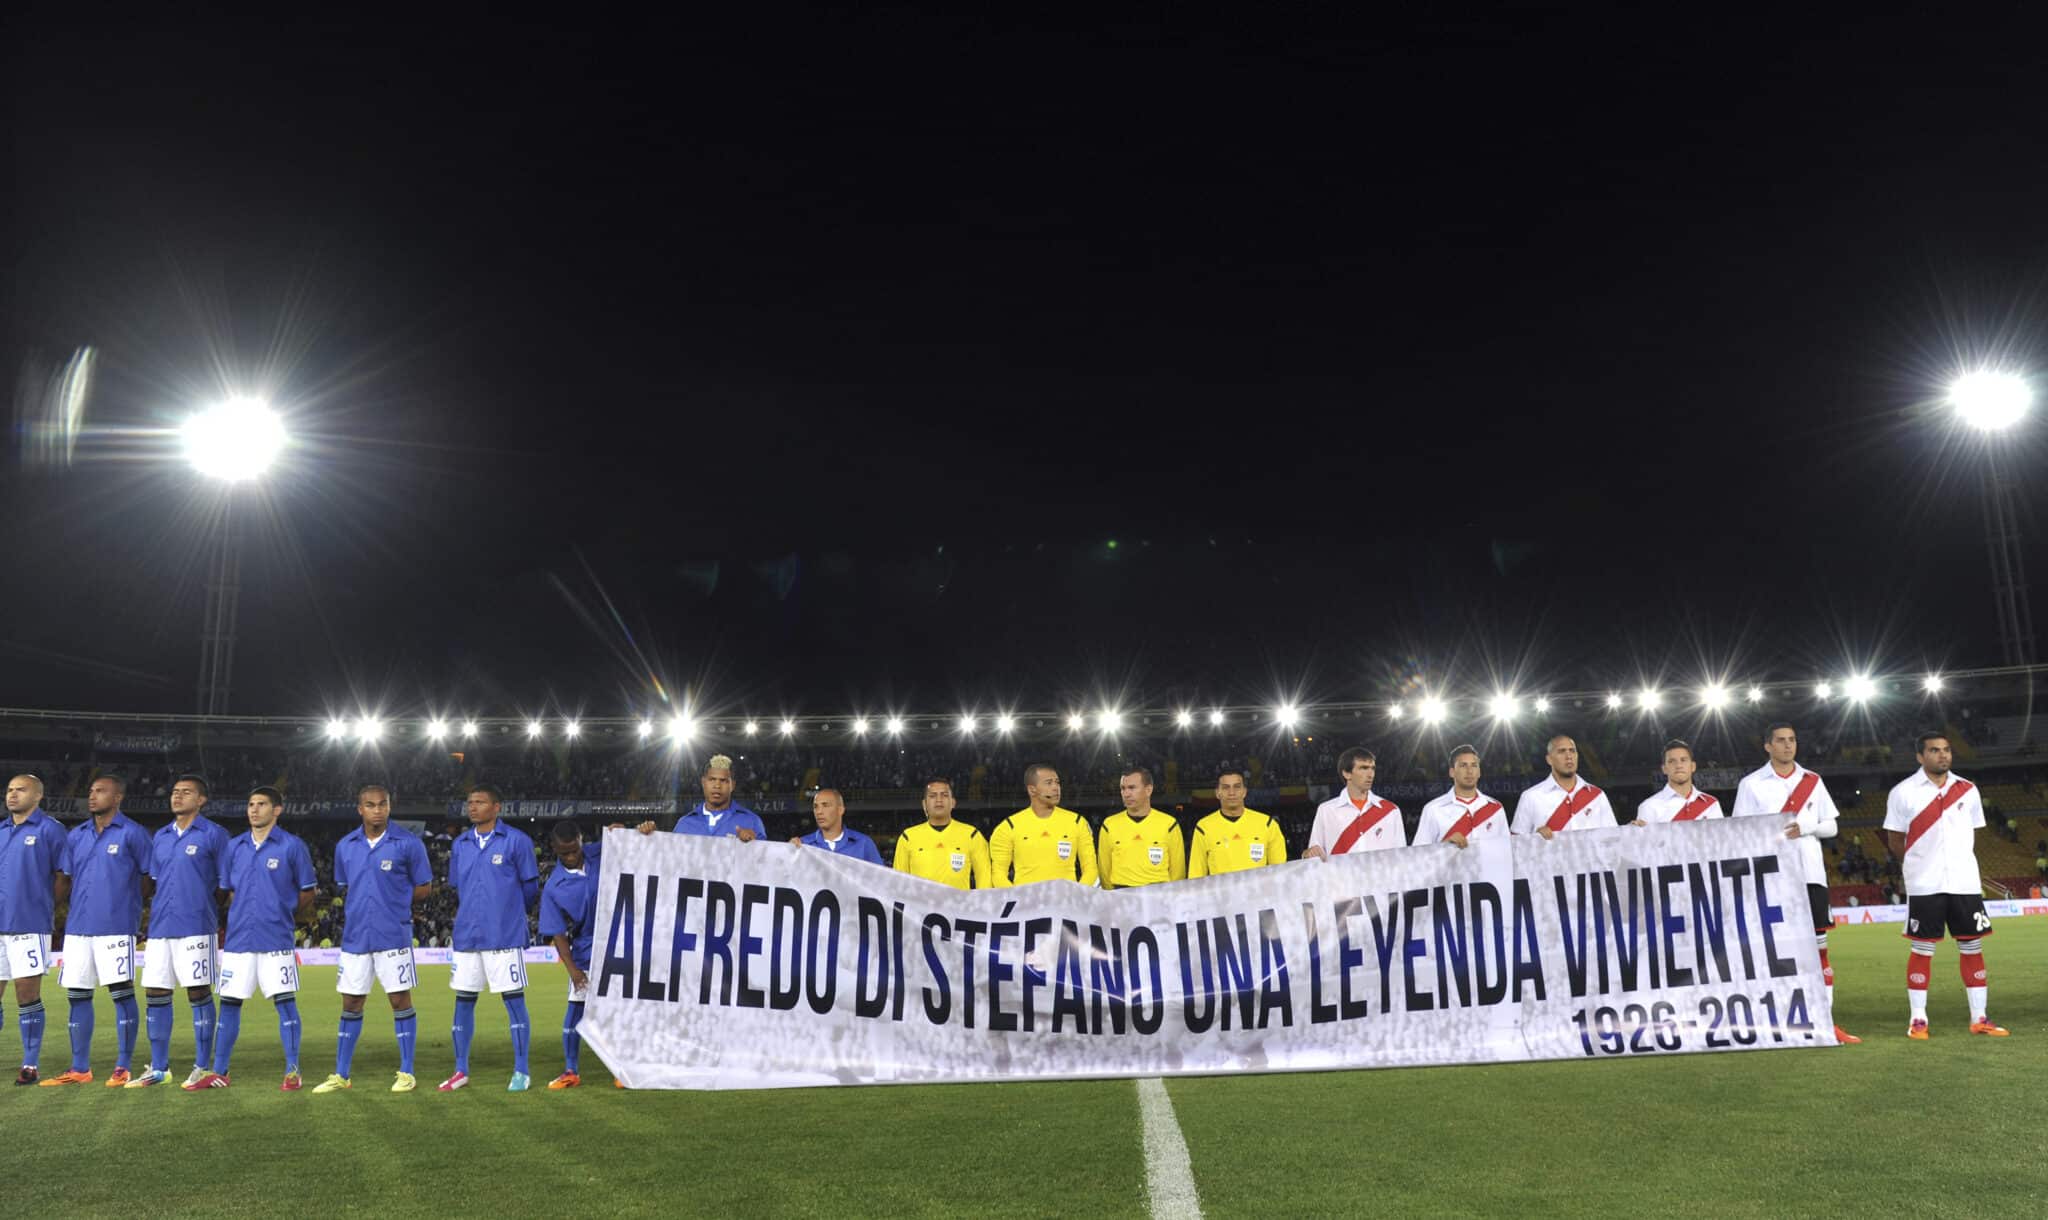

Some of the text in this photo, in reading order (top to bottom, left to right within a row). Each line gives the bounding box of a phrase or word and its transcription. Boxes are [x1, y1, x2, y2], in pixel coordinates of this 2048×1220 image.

[597, 855, 1798, 1036] ALFREDO DI STÉFANO UNA LEYENDA VIVIENTE
[27, 949, 39, 968] 5
[192, 958, 208, 980] 26
[509, 963, 519, 983] 6
[1572, 987, 1815, 1056] 1926-2014
